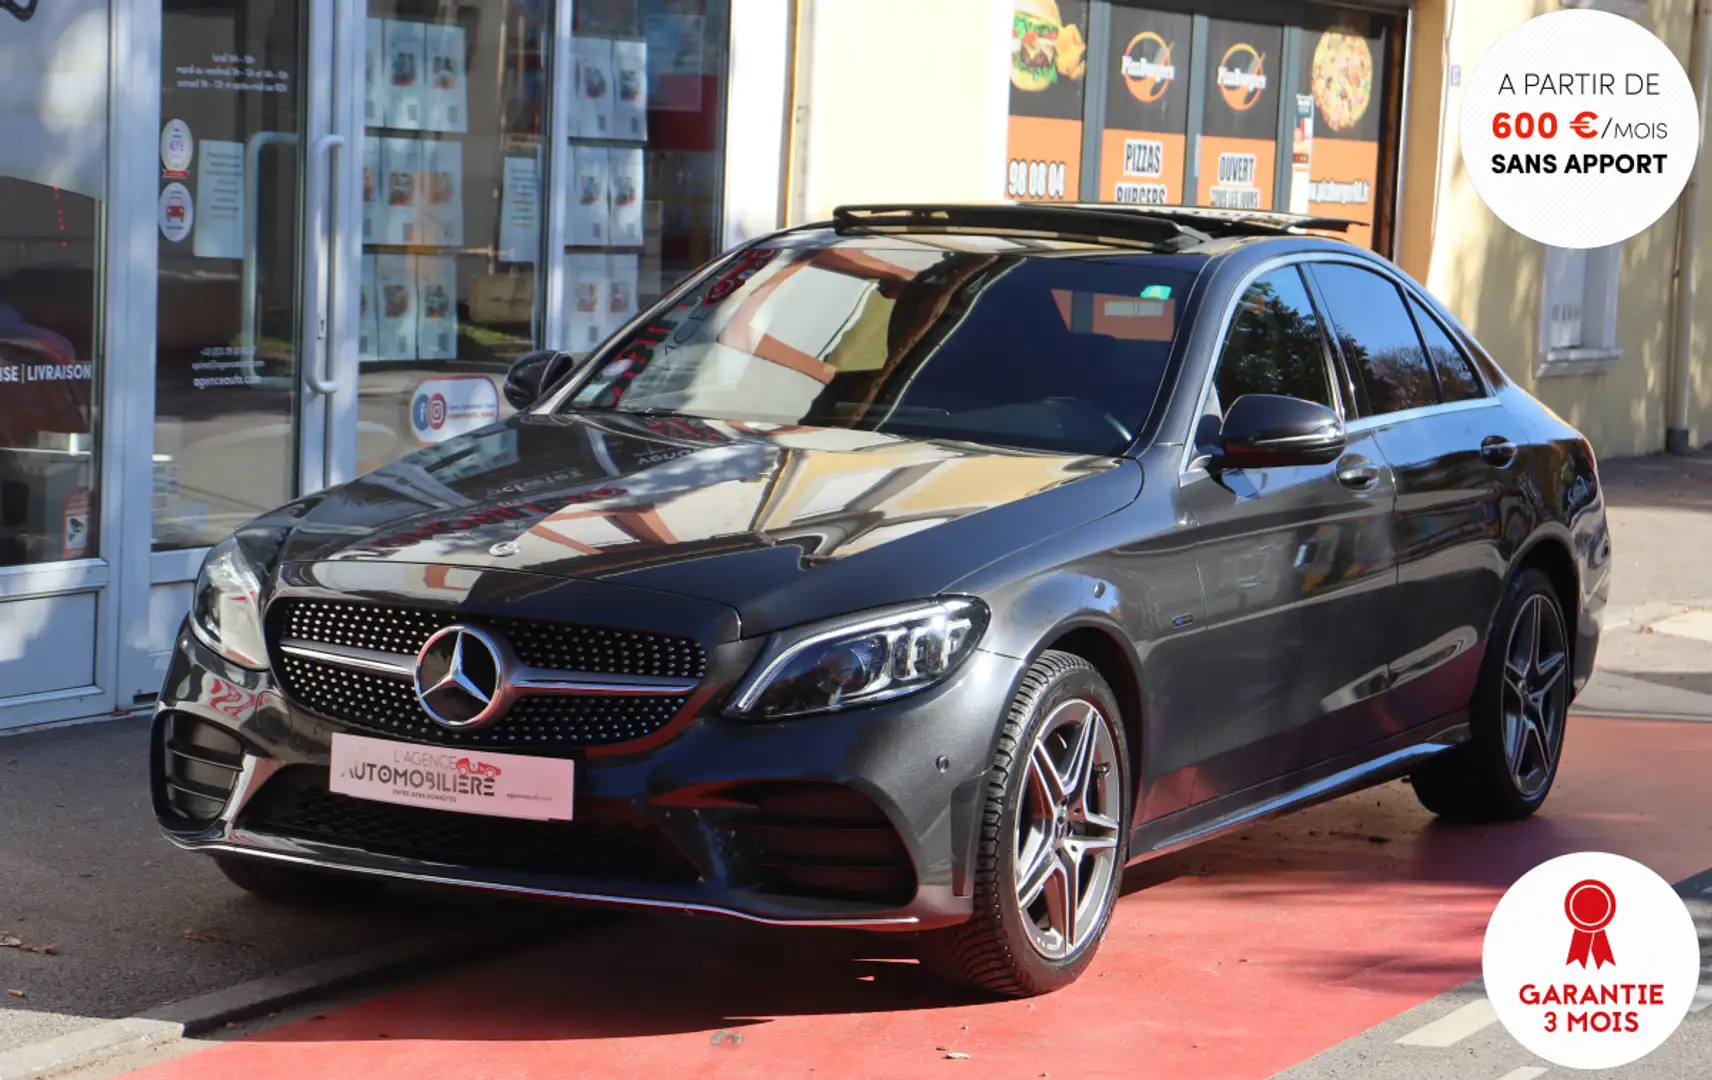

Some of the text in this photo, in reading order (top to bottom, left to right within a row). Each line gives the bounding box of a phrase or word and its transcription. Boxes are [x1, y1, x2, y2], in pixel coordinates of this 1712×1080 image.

[1125, 143, 1161, 174] PIZZAS
[1218, 156, 1254, 182] OUVERT
[27, 363, 92, 381] LIVRAISON
[393, 749, 457, 771] L'AGENCE
